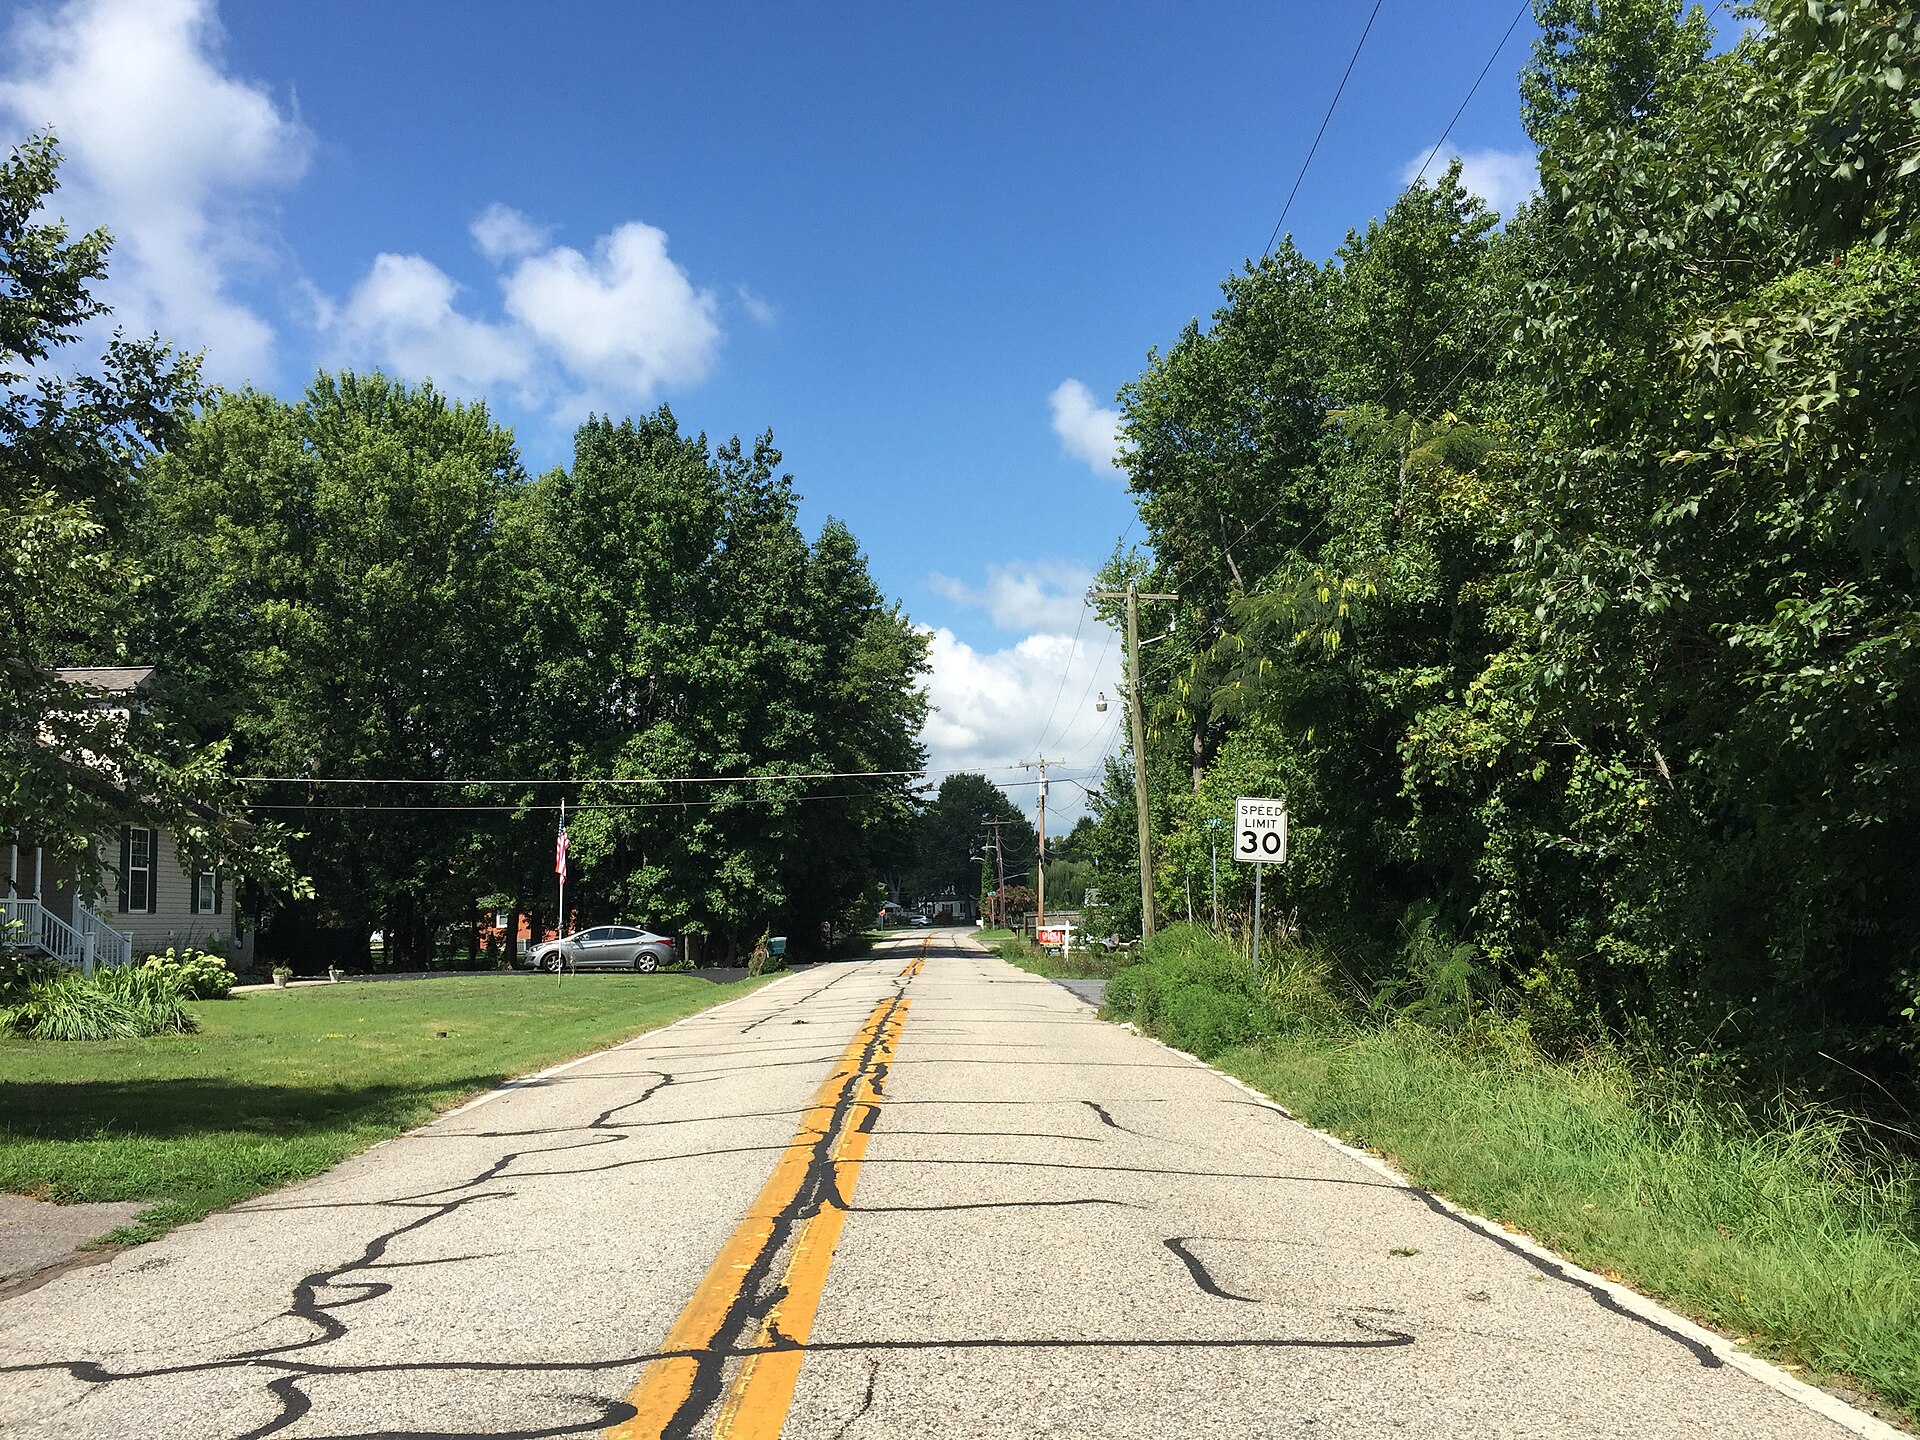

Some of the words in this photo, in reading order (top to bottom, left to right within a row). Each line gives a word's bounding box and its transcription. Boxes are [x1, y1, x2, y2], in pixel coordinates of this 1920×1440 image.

[1241, 805, 1283, 816] SPEED
[1245, 818, 1277, 829] LIMIT
[1240, 831, 1281, 854] 30
